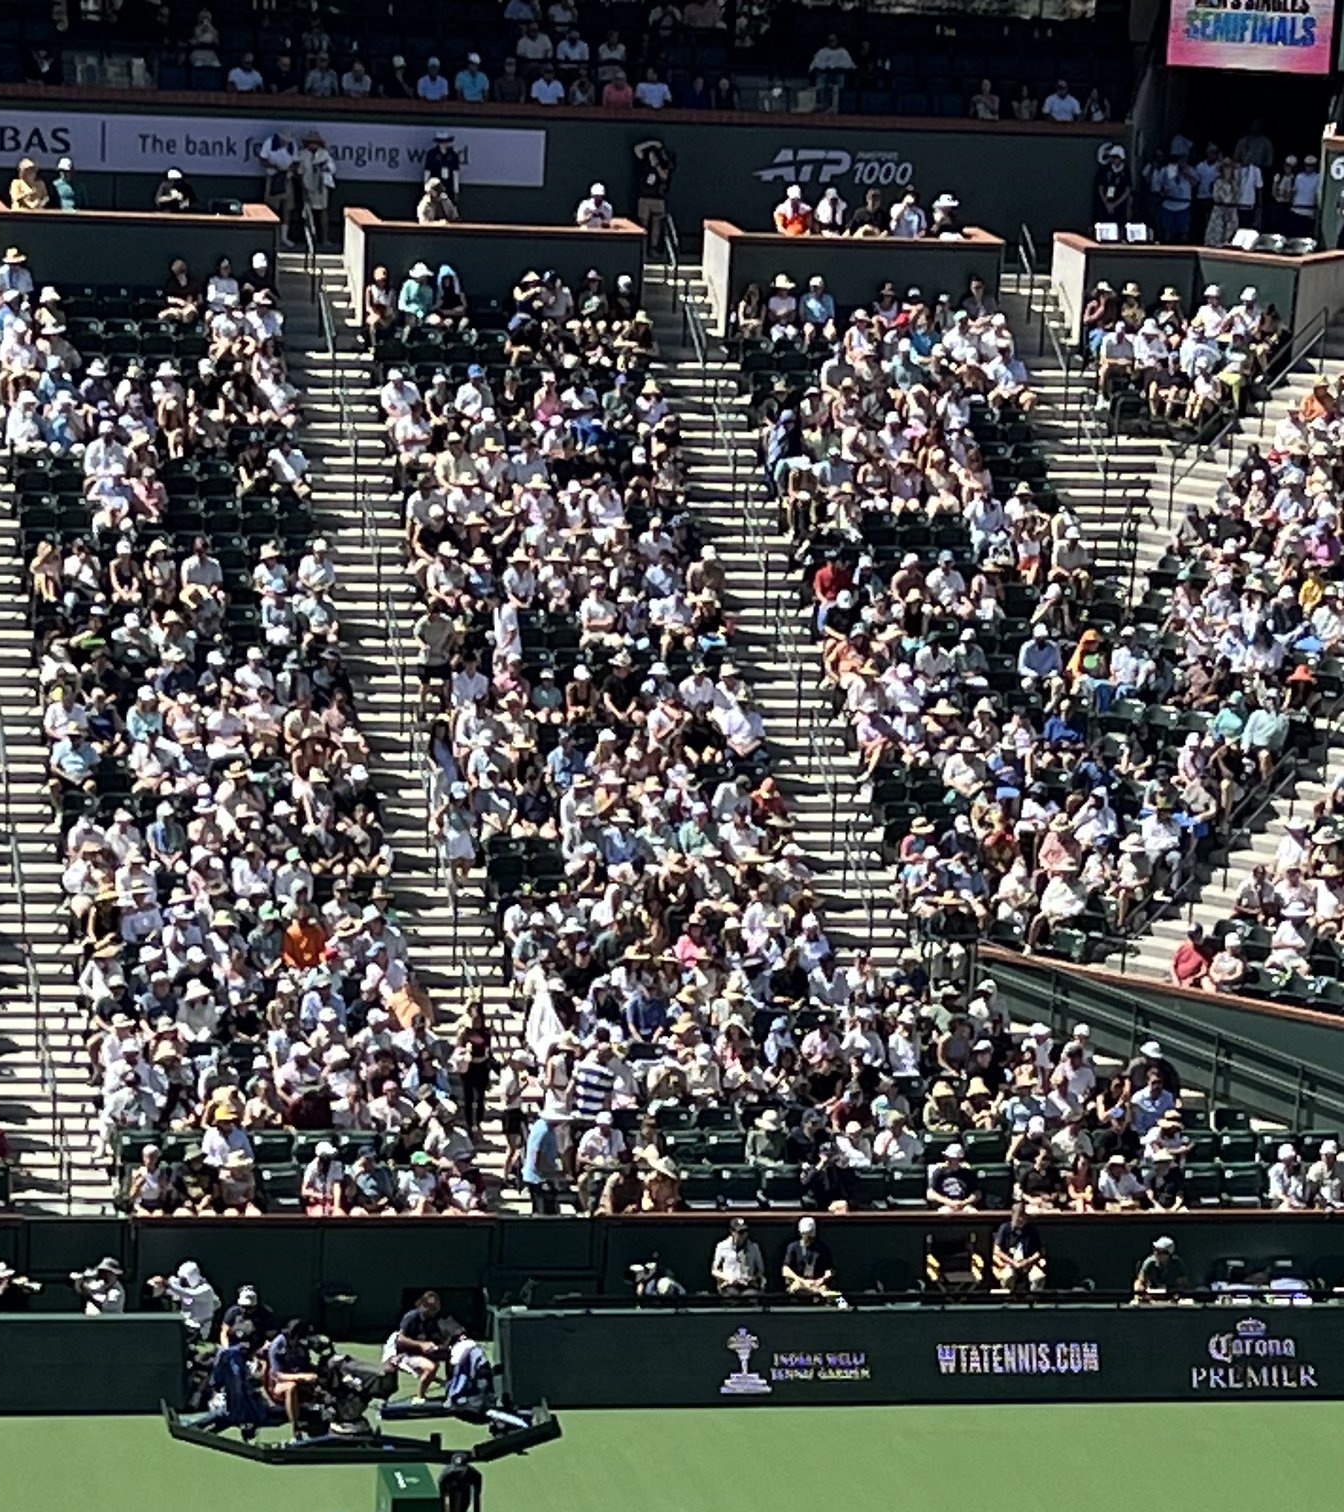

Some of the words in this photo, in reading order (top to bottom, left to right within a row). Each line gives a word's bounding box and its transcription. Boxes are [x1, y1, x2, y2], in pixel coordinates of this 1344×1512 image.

[138, 133, 177, 155] The
[185, 134, 237, 157] bank
[330, 144, 400, 169] anging
[752, 148, 852, 182] ATP
[853, 160, 913, 185] 1000
[936, 1342, 1100, 1374] WTATENNIS.COM
[1207, 1332, 1297, 1364] Corona
[1190, 1365, 1319, 1389] PREMIER
